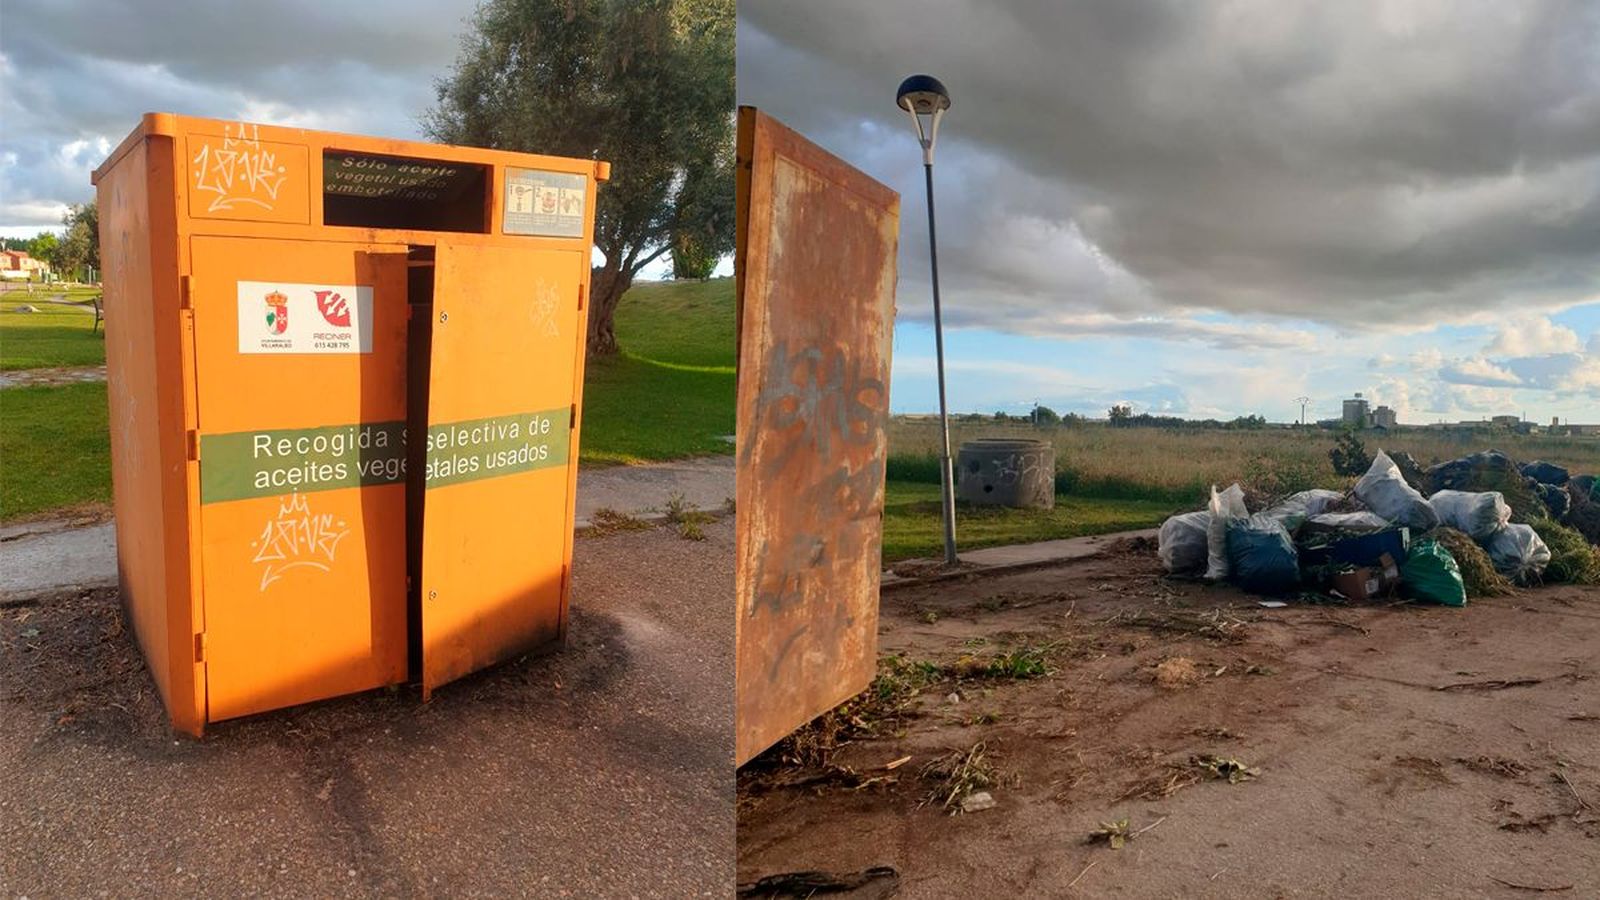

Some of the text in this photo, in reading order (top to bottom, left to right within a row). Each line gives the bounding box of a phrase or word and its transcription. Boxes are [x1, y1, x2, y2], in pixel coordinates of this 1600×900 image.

[335, 171, 396, 185] vegetal
[398, 165, 457, 177] aceite
[253, 426, 388, 459] Recogida
[529, 415, 550, 436] de
[254, 461, 348, 488] aceites
[486, 442, 548, 469] usados
